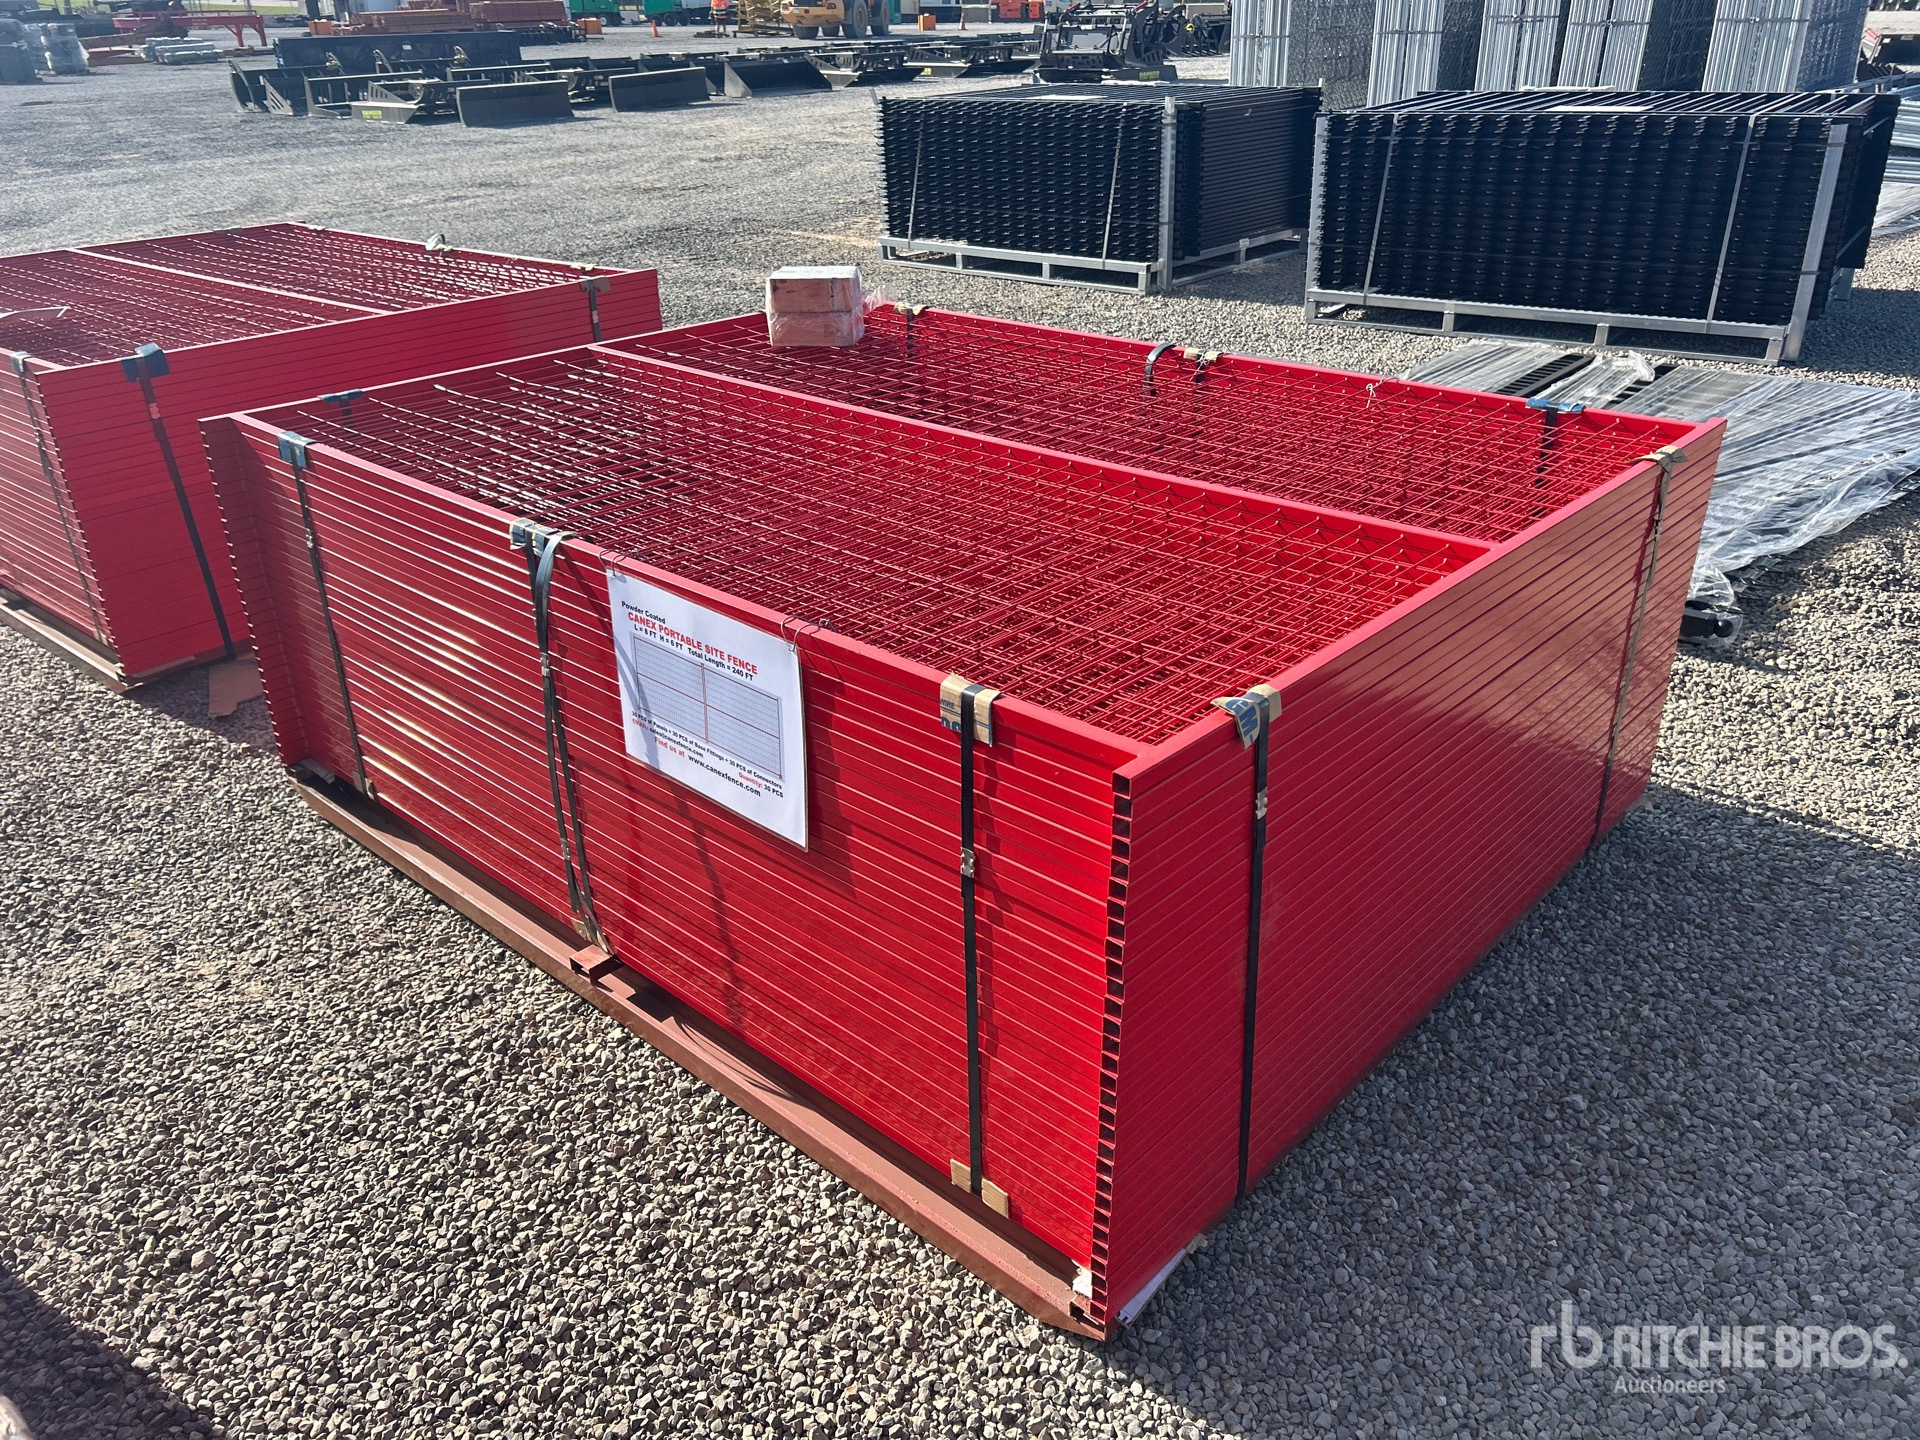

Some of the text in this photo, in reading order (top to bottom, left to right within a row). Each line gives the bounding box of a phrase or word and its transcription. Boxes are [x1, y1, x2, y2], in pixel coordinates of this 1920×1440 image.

[621, 601, 666, 624] Powder Coated
[628, 612, 758, 675] CANEX PORTABLE SITE FENCE
[649, 630, 657, 638] FT
[659, 634, 664, 642] H
[675, 642, 683, 650] FT
[688, 647, 703, 659] Total
[704, 654, 726, 669] Length
[732, 666, 744, 677] 240
[745, 672, 754, 681] FT
[638, 713, 647, 722] PCS
[653, 721, 668, 733] Panels
[672, 730, 678, 738] 30
[679, 734, 688, 743] PCS
[694, 742, 706, 752] Base
[706, 748, 724, 761] Fittings
[736, 763, 746, 772] PCS
[753, 771, 782, 789] Connectors
[649, 727, 704, 758] sales@canexfence.com
[738, 772, 763, 788] Quantity:
[764, 784, 771, 792] 30
[772, 788, 783, 798] PCS
[654, 736, 761, 797] Find us at www.canexfence.com
